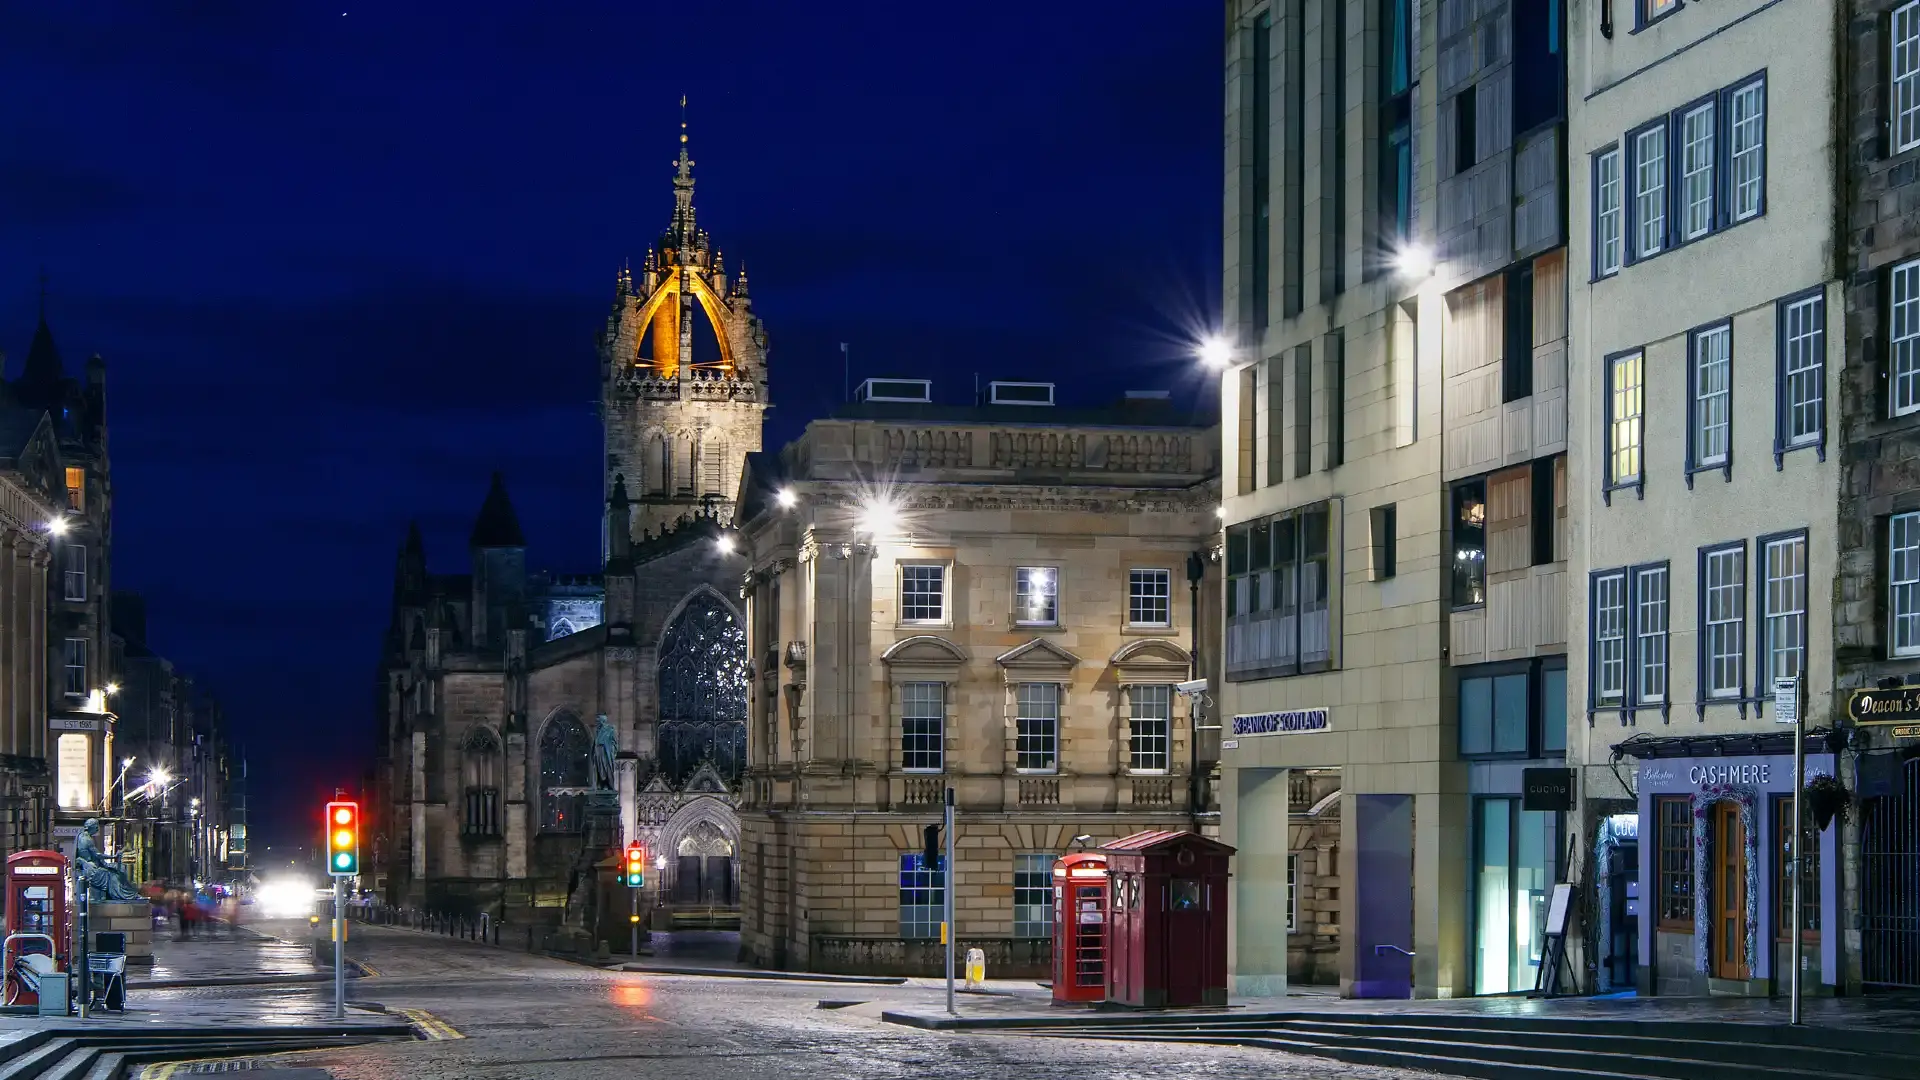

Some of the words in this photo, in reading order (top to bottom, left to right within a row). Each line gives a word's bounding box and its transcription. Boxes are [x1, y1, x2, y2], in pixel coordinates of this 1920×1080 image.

[1861, 691, 1912, 714] Deacon's
[1242, 715, 1265, 733] BANK
[1265, 714, 1279, 732] OF
[1280, 709, 1325, 731] SCOTLAND
[1689, 764, 1769, 785] CASHMERE
[1529, 784, 1566, 794] cucina
